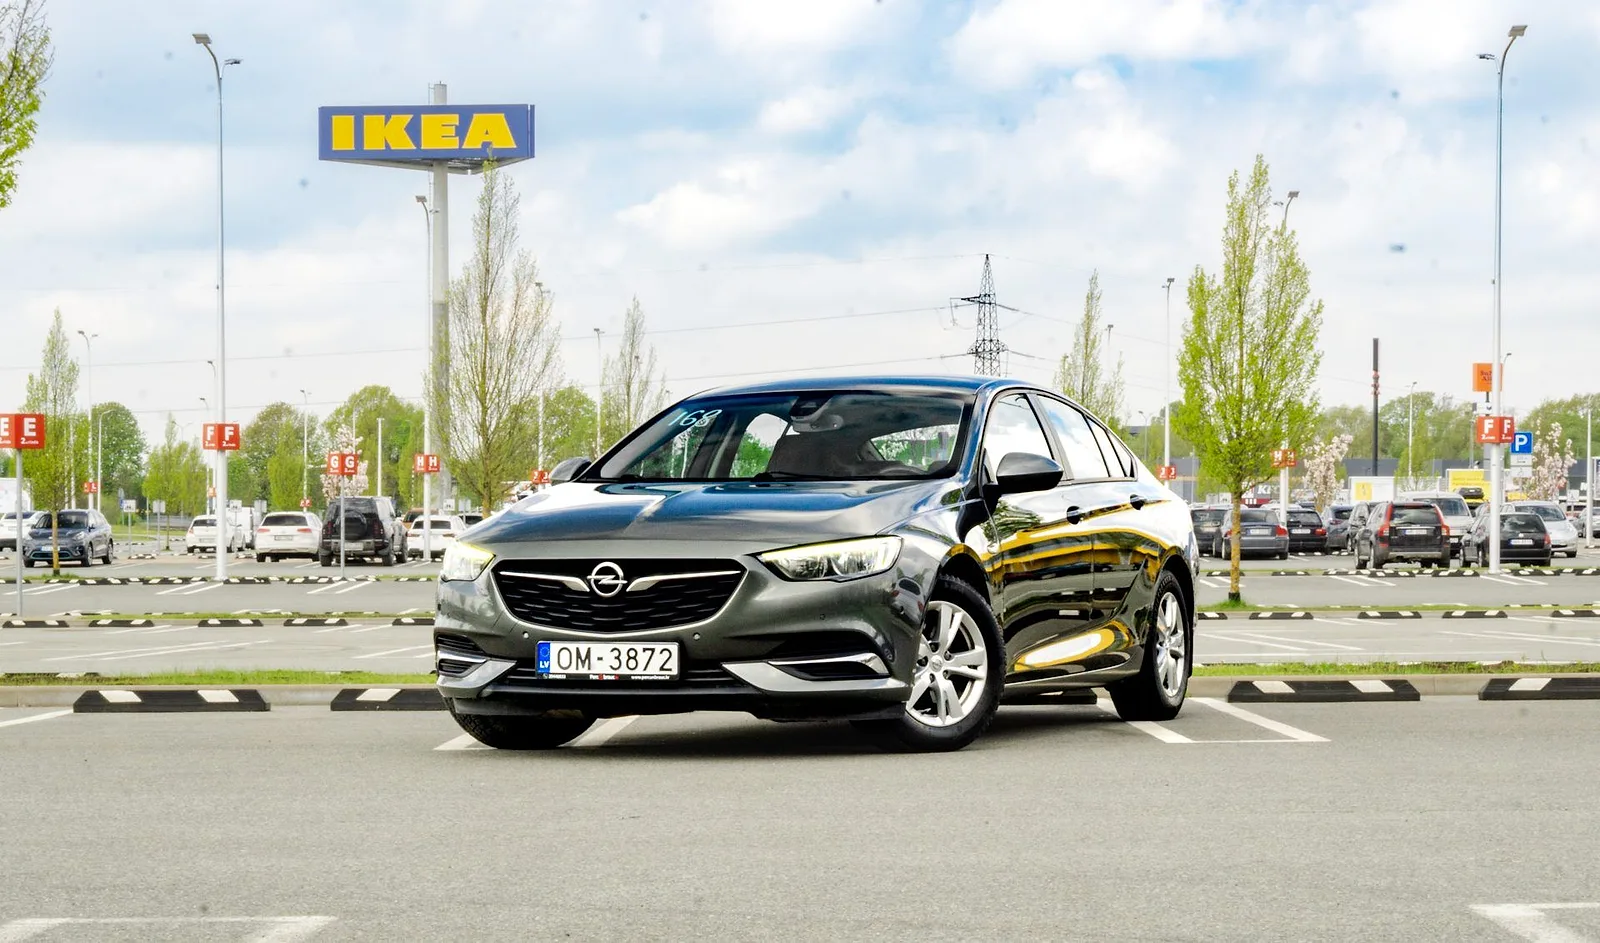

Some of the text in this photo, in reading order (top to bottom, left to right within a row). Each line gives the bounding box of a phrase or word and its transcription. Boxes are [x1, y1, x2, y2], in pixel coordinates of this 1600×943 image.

[331, 113, 517, 151] IKEA
[668, 409, 723, 427] 168
[23, 417, 37, 436] E
[207, 426, 214, 440] F
[225, 426, 234, 440] F
[1484, 419, 1494, 434] F
[1504, 419, 1511, 434] F
[1515, 434, 1528, 451] P
[330, 455, 339, 468] G
[345, 455, 355, 468] G
[417, 456, 424, 466] H
[429, 456, 437, 466] H
[557, 646, 672, 672] OM-3872
